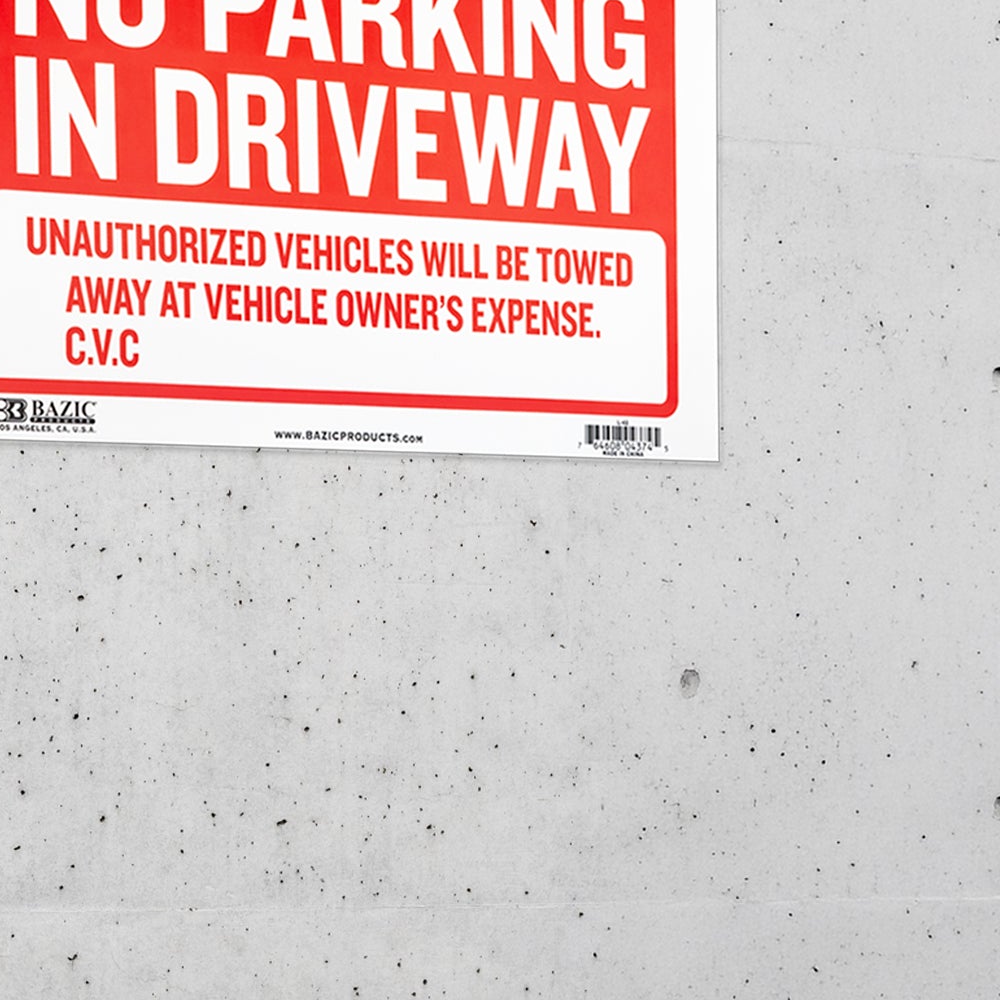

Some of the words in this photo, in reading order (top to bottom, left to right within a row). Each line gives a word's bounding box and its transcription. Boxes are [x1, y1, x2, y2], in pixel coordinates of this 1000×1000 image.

[14, 55, 118, 181] IN
[154, 66, 651, 215] DRIVEWAY
[26, 217, 266, 268] UNAUTHORIZED
[274, 233, 414, 276] VEHICLES
[421, 240, 489, 280] WILL
[497, 245, 530, 282] BE
[536, 248, 633, 288] TOWED
[66, 275, 152, 317] AWAY
[159, 281, 196, 319] AT
[204, 284, 328, 325] VEHICLE
[336, 289, 464, 332] OWNER'S
[471, 297, 601, 338] EXPENSE.
[66, 327, 139, 368] C.V.C
[32, 400, 97, 418] BAZIC
[664, 445, 669, 453] 5
